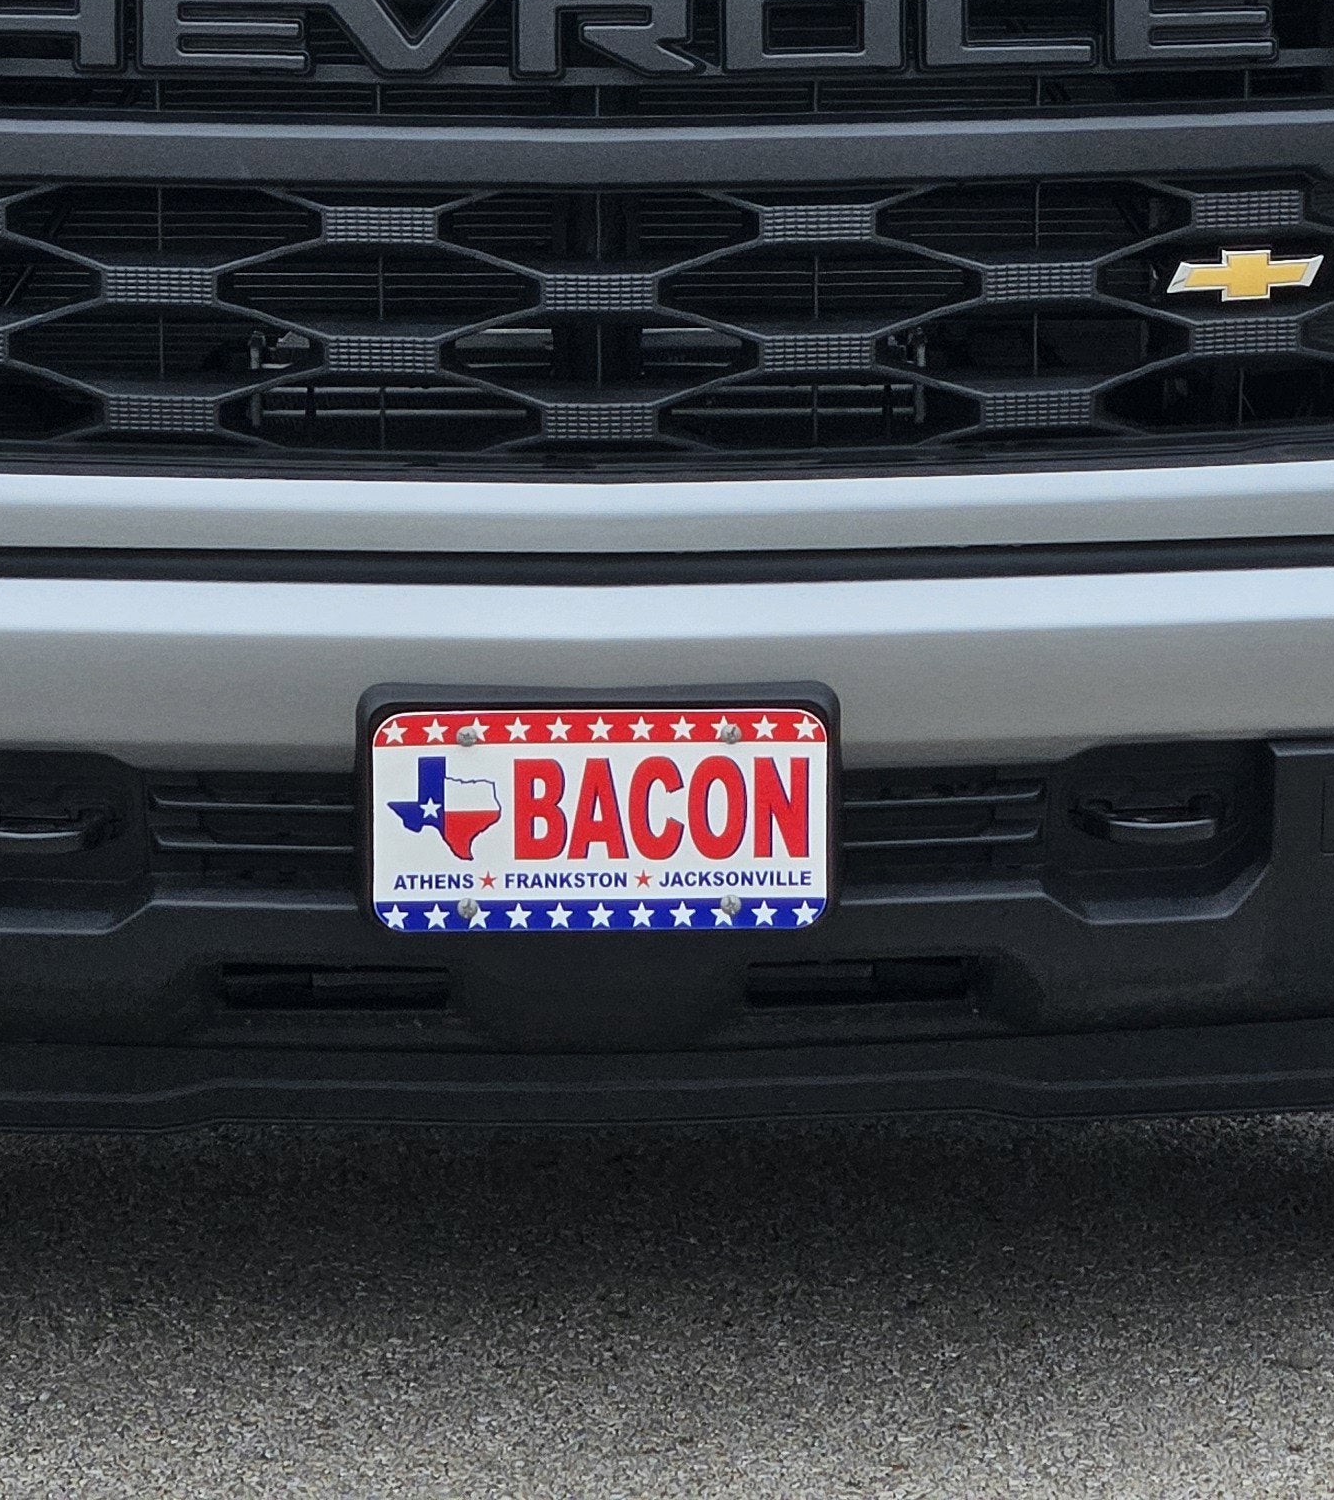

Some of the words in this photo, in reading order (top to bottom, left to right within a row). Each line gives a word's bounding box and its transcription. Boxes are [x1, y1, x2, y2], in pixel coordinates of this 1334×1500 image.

[512, 755, 810, 861] BACON
[393, 872, 475, 891] ATHENS
[504, 871, 628, 890] FRANKSTON
[658, 869, 812, 888] JACKSONVILLE
